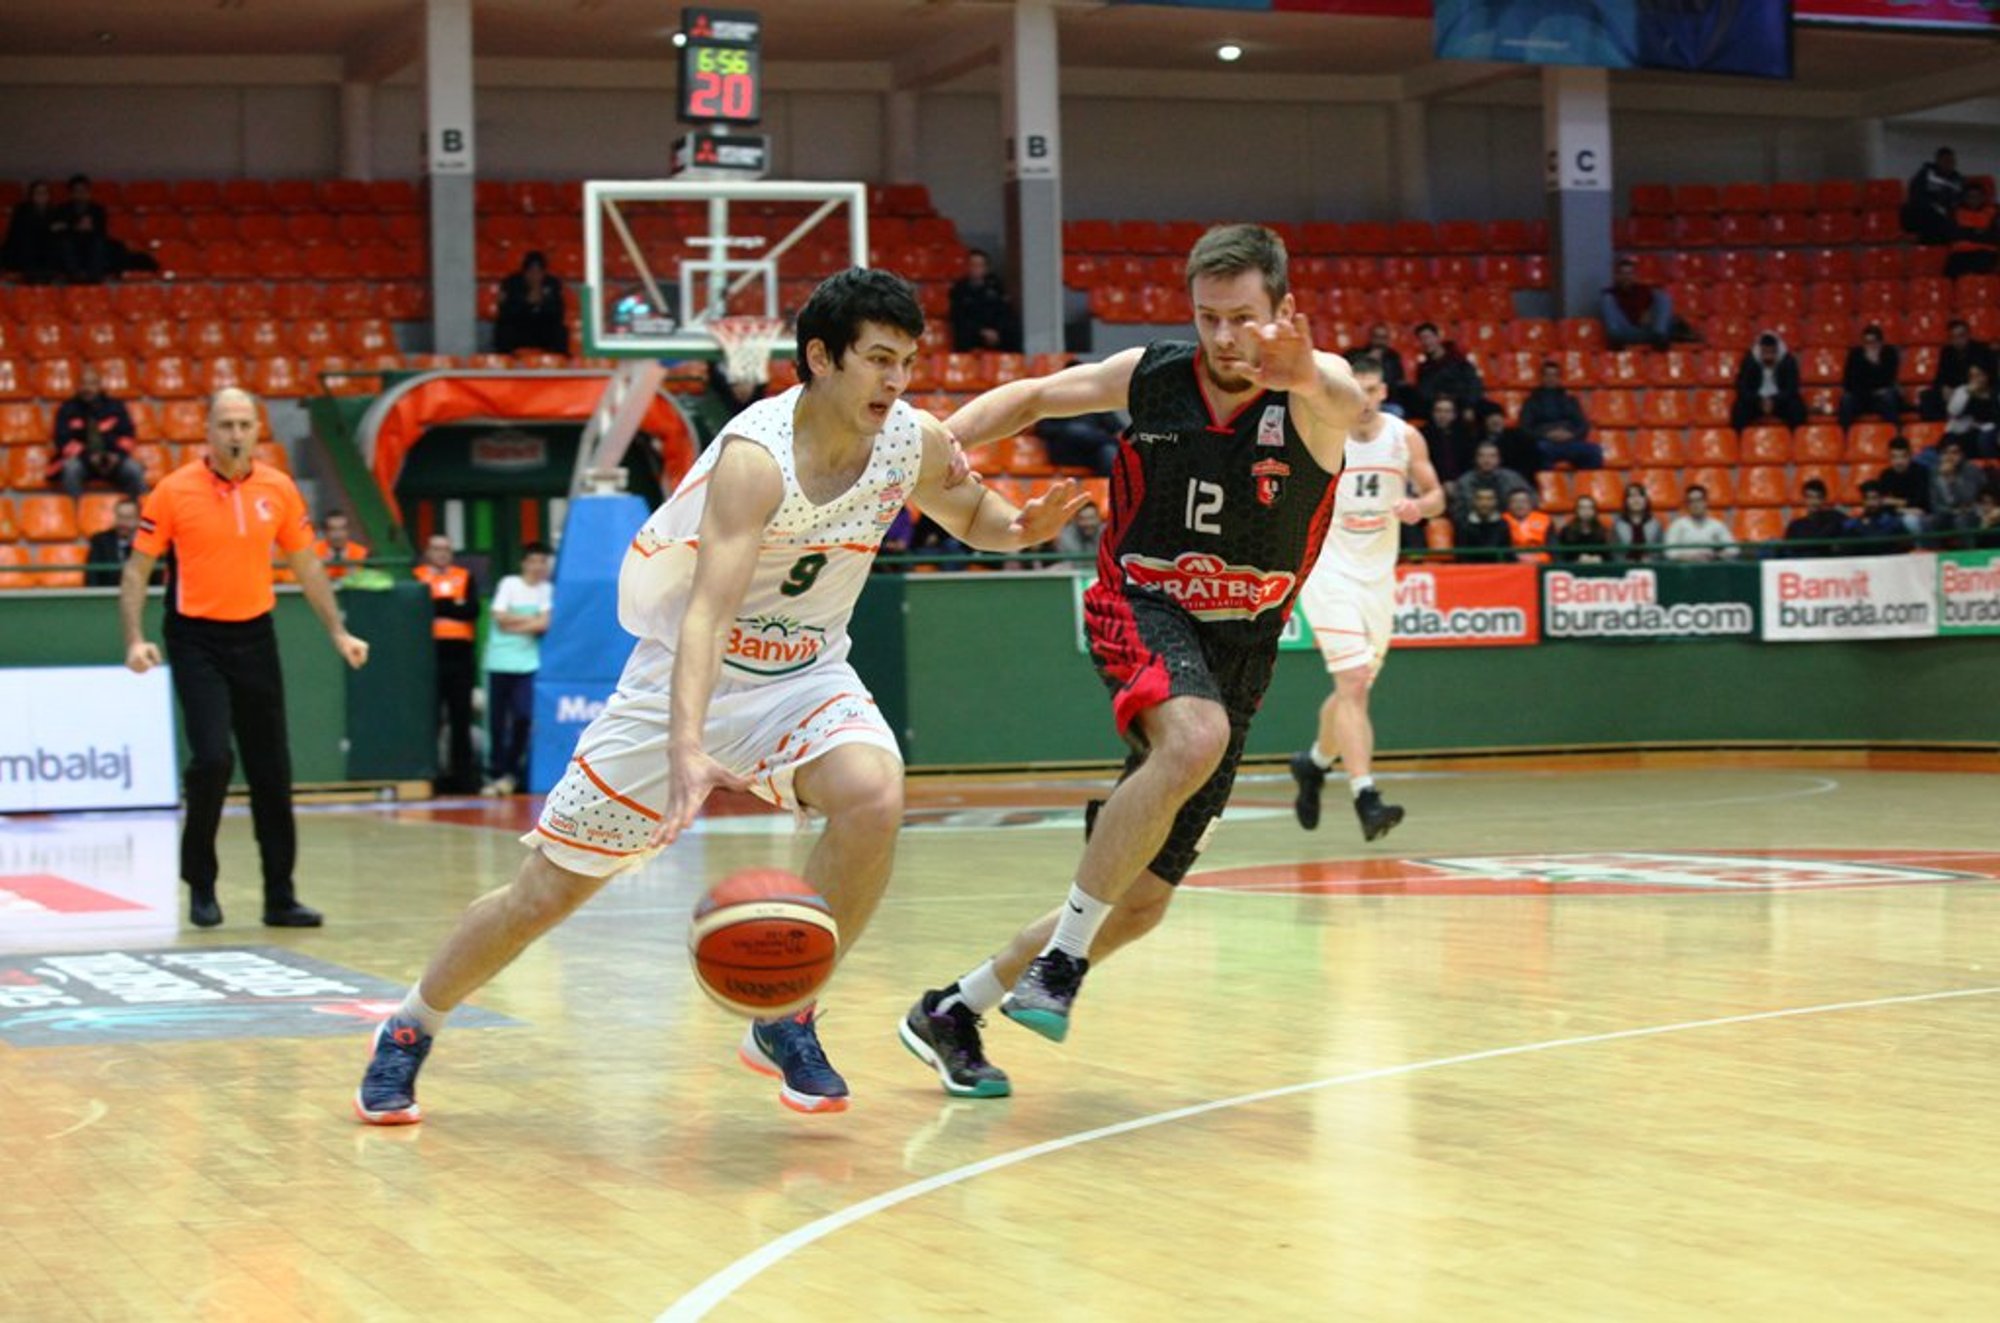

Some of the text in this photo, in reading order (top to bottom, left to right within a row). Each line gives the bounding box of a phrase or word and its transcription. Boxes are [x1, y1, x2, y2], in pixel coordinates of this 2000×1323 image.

[689, 71, 754, 118] 20
[442, 129, 464, 153] B
[1028, 135, 1048, 158] B
[1575, 149, 1596, 173] C
[1355, 473, 1380, 498] 14
[1185, 477, 1224, 535] 12
[780, 552, 828, 597] 9
[1778, 570, 1870, 600] Banvit
[1143, 577, 1281, 605] RATBEY
[1551, 574, 1651, 604] Banvit
[1551, 604, 1749, 632] burada.com
[1778, 600, 1928, 628] burada.com
[0, 745, 132, 790] mbalaj
